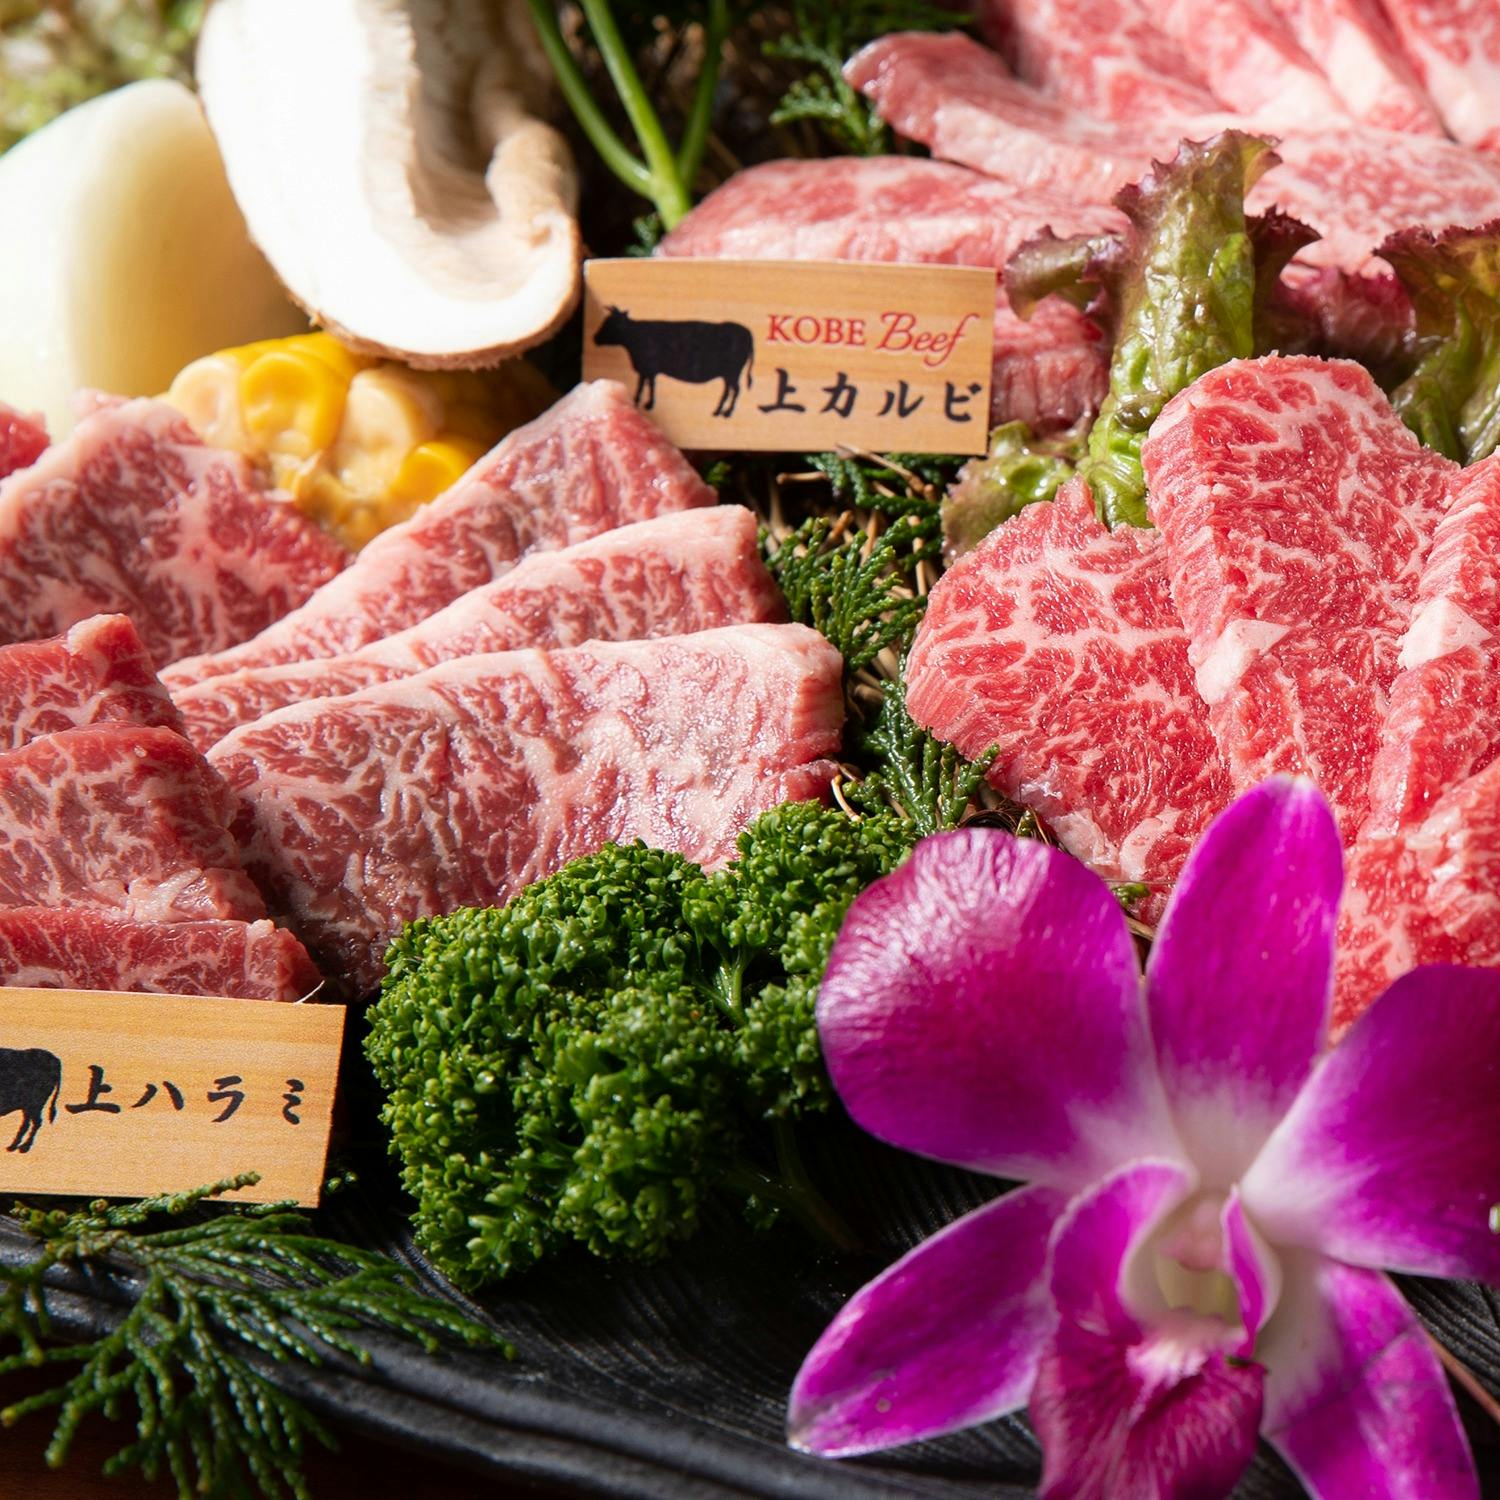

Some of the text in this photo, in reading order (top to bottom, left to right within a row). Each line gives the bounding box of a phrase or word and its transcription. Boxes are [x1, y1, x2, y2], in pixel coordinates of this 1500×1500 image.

[767, 311, 981, 367] KOBE Beef
[757, 368, 982, 423] 上カルビ
[65, 1064, 305, 1126] 上ハラミ
